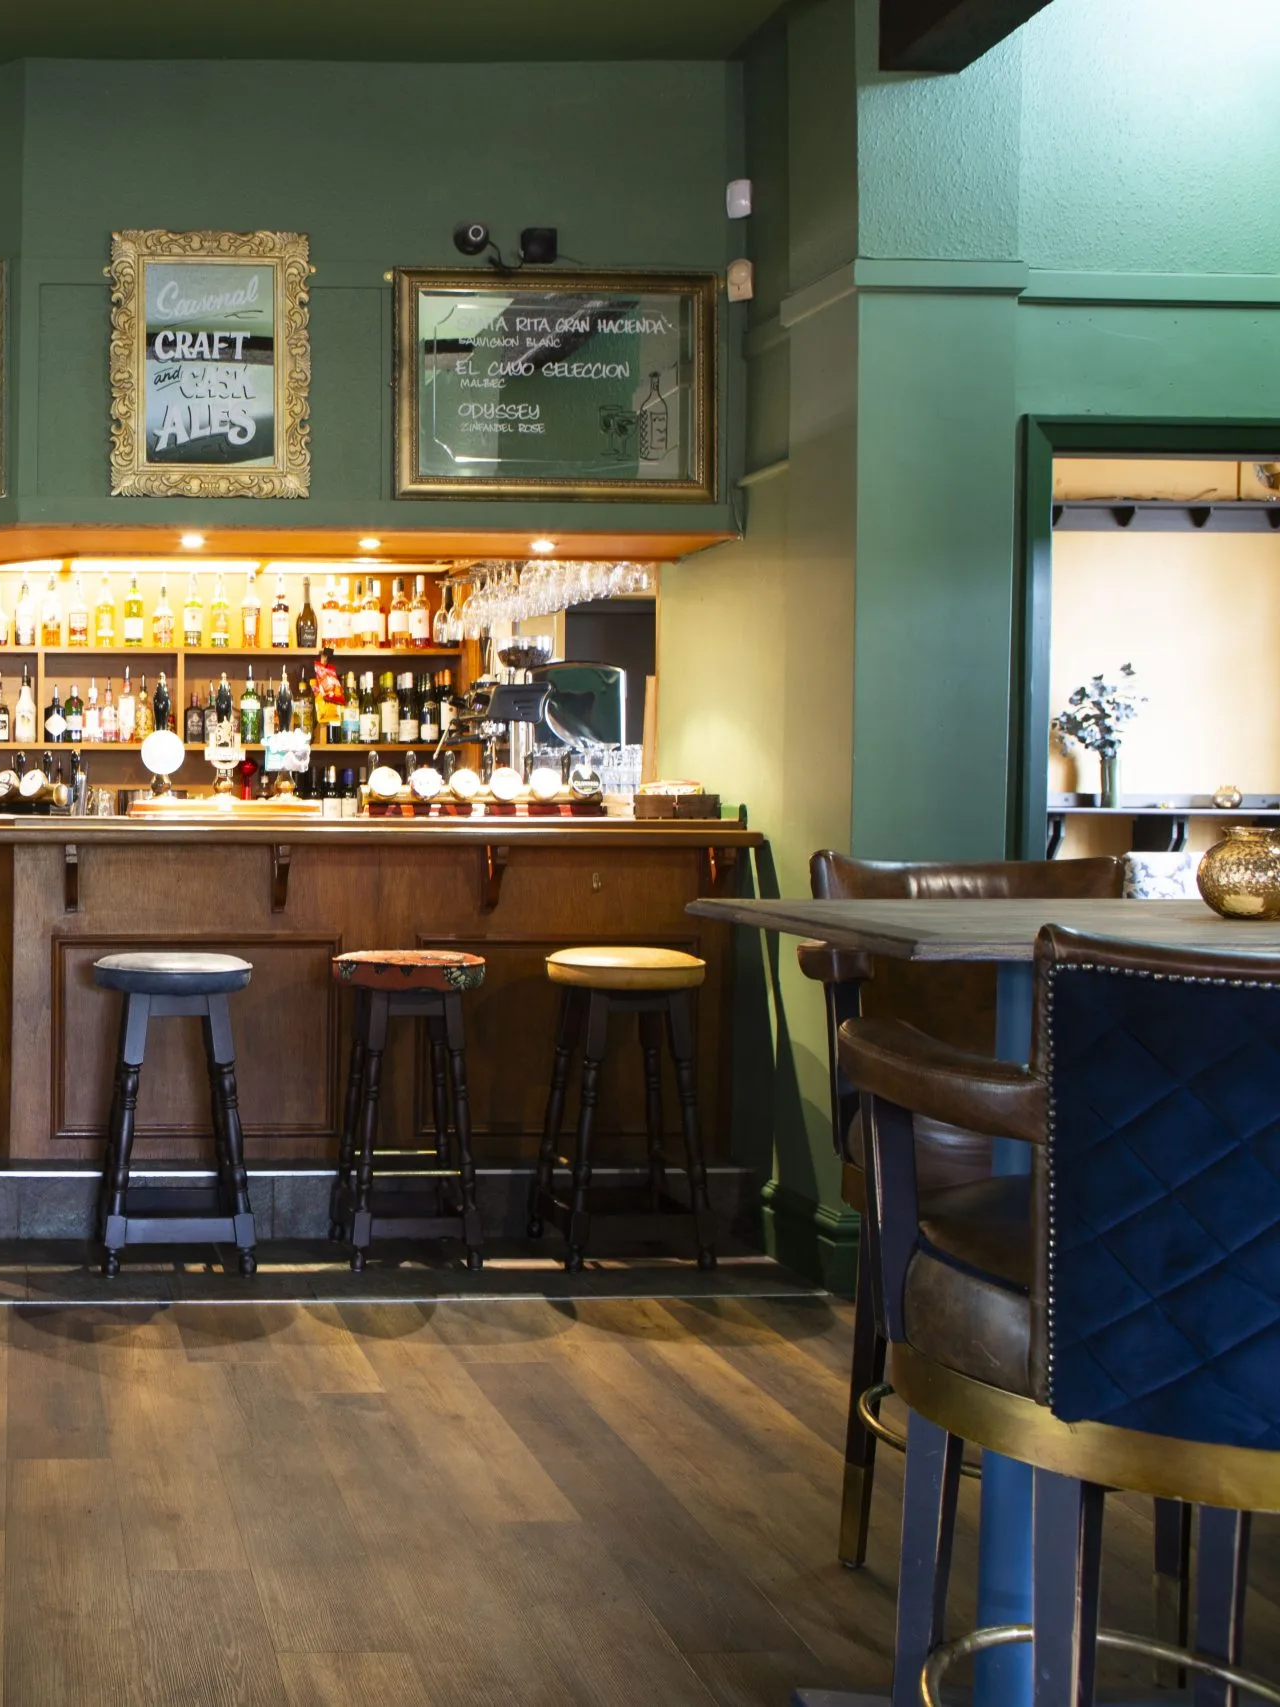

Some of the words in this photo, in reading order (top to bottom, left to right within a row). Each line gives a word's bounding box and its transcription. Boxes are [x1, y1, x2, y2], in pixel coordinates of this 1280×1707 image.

[157, 274, 259, 320] Seasonal
[516, 315, 551, 332] RITA
[555, 316, 590, 333] GRAN
[597, 319, 666, 335] HACIENDA
[154, 329, 251, 360] CRAFT
[458, 336, 519, 348] SAUVIGNON
[526, 337, 562, 349] BLANC
[455, 359, 480, 376] EL
[541, 361, 631, 378] SELECCION
[153, 364, 182, 386] and
[182, 364, 256, 399] CASK
[460, 377, 508, 389] MALBEC
[457, 403, 540, 420] ODYSSEY
[152, 402, 257, 451] ALES
[461, 422, 514, 434] ZINFANDEL
